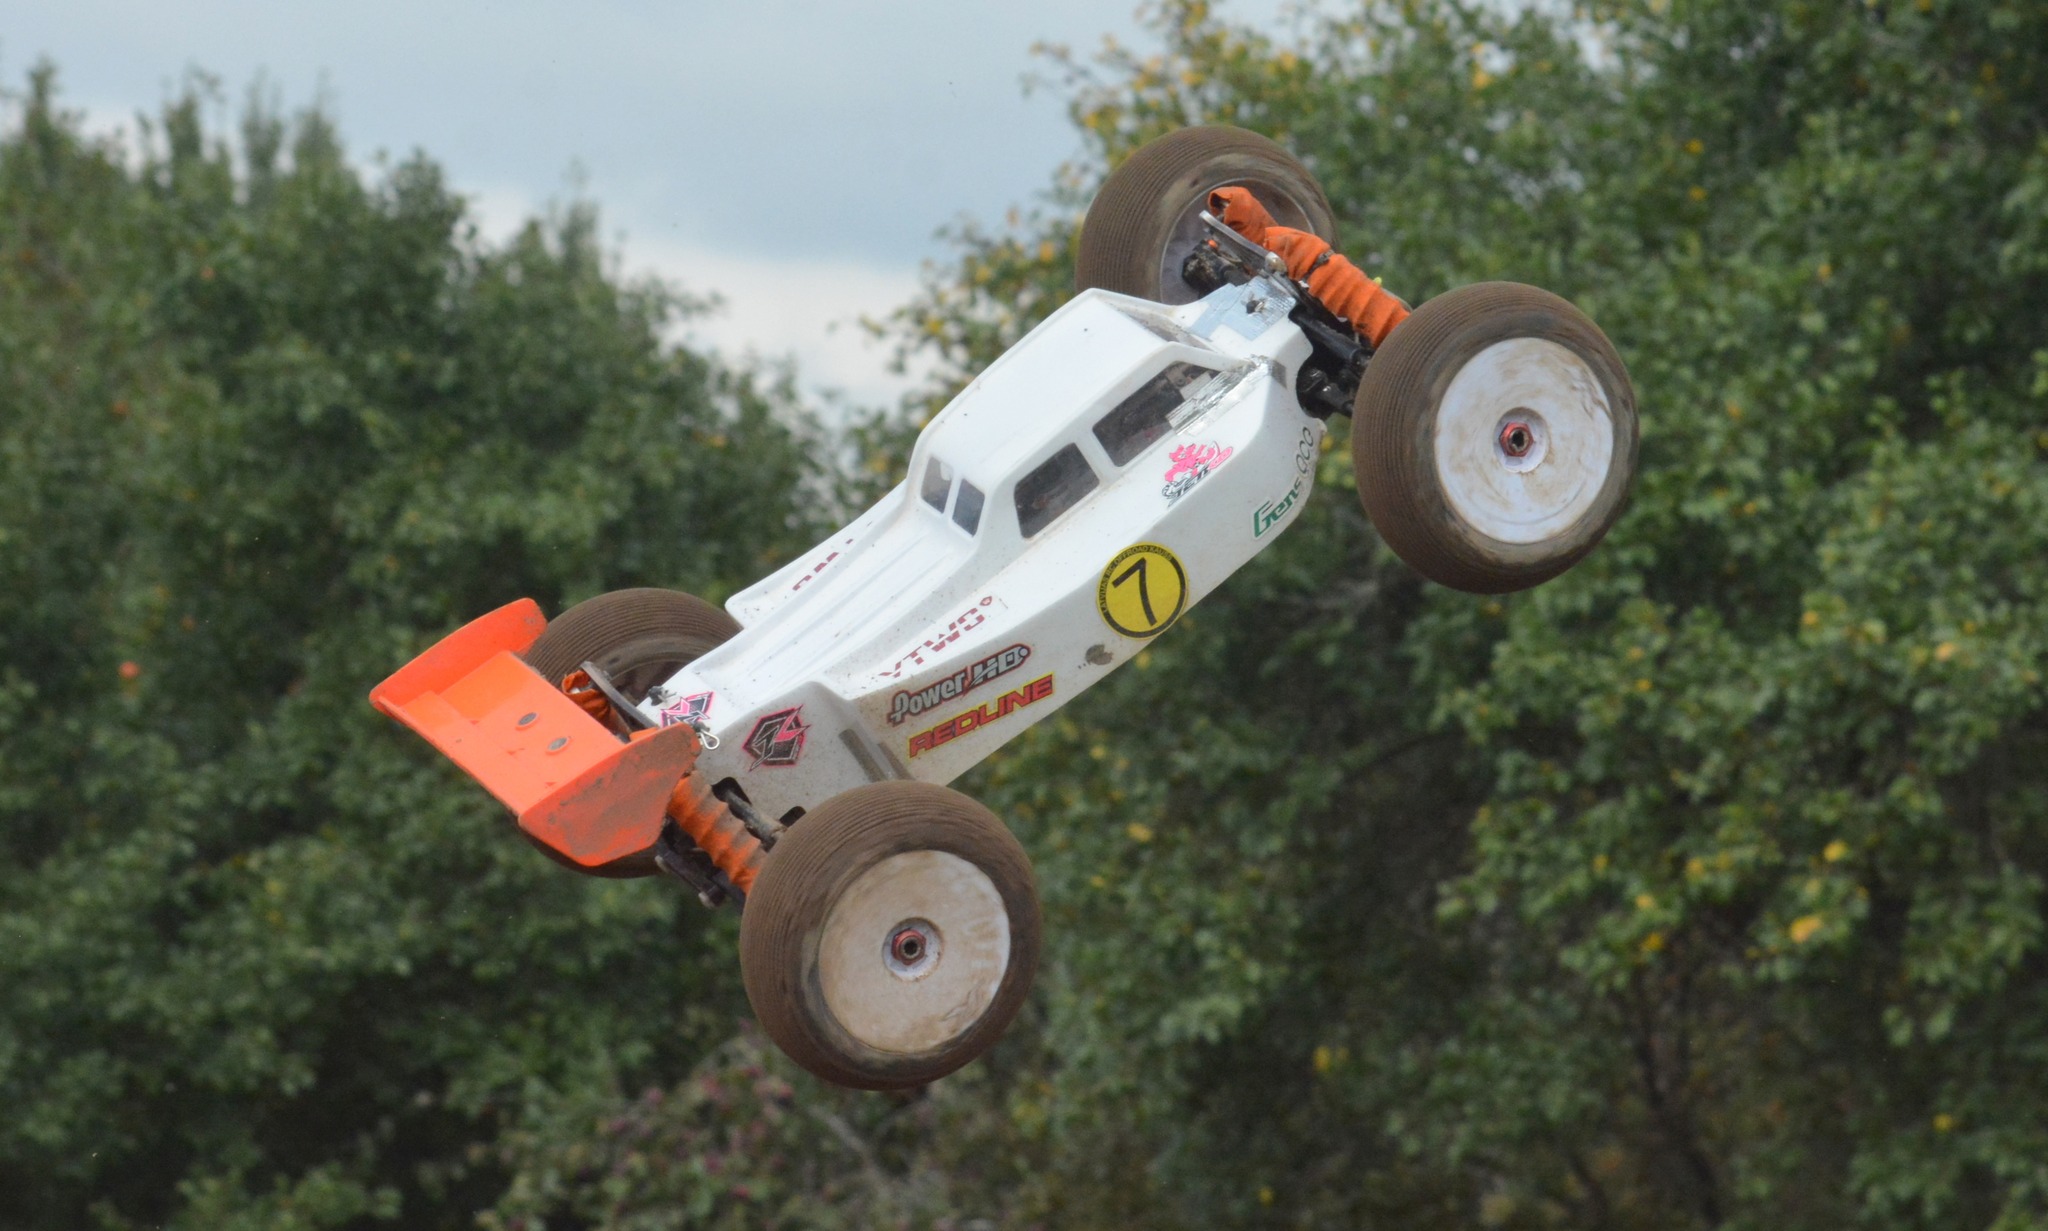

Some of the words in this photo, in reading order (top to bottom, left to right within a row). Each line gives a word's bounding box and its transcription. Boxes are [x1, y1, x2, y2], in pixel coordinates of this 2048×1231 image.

[1254, 477, 1301, 538] Gens
[1111, 557, 1157, 627] 7
[888, 671, 967, 726] Power
[968, 645, 1024, 688] HD
[909, 674, 1053, 759] REDLINE
